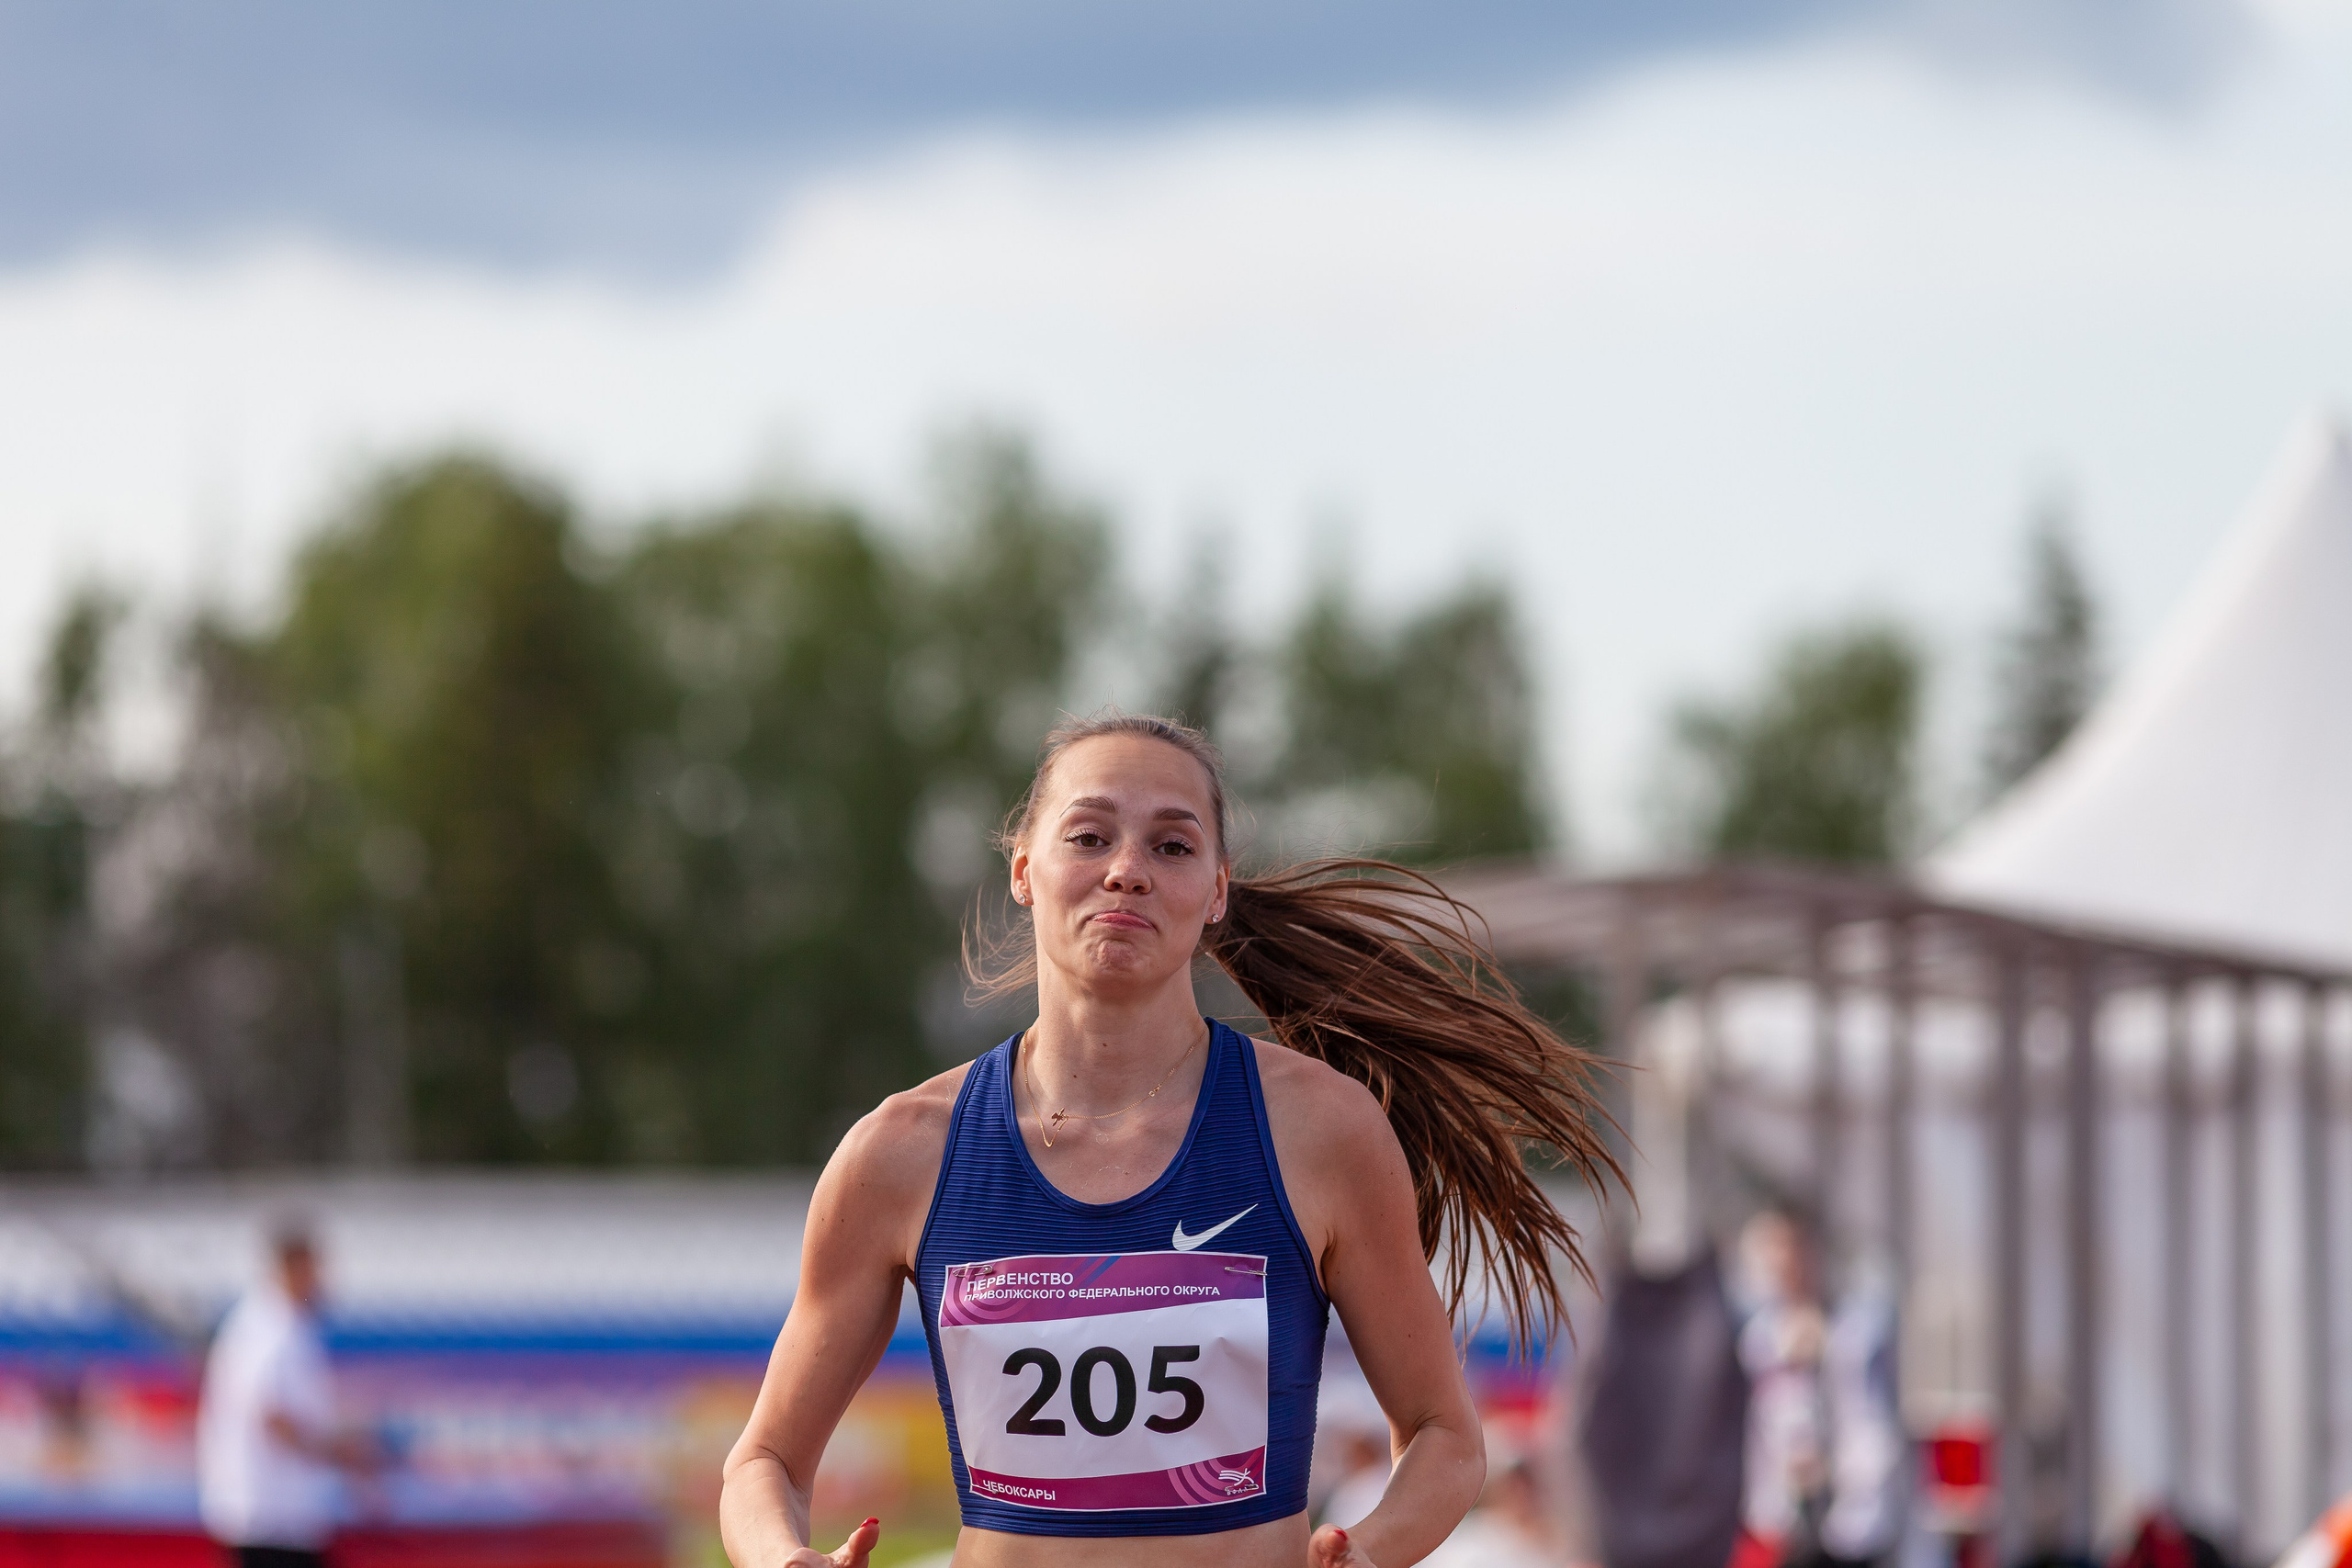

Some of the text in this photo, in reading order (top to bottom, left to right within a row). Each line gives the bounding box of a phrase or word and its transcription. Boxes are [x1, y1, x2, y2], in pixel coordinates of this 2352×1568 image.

[967, 1272, 1074, 1292] ПЕРВЕНСТВО
[964, 1285, 1220, 1302] ПРИВОЛЖСКОГО ФЕДЕРАЛЬНОГО ОКРУГА
[1001, 1345, 1205, 1437] 205
[982, 1479, 1056, 1501] ЧЕБОКСАРЫ
